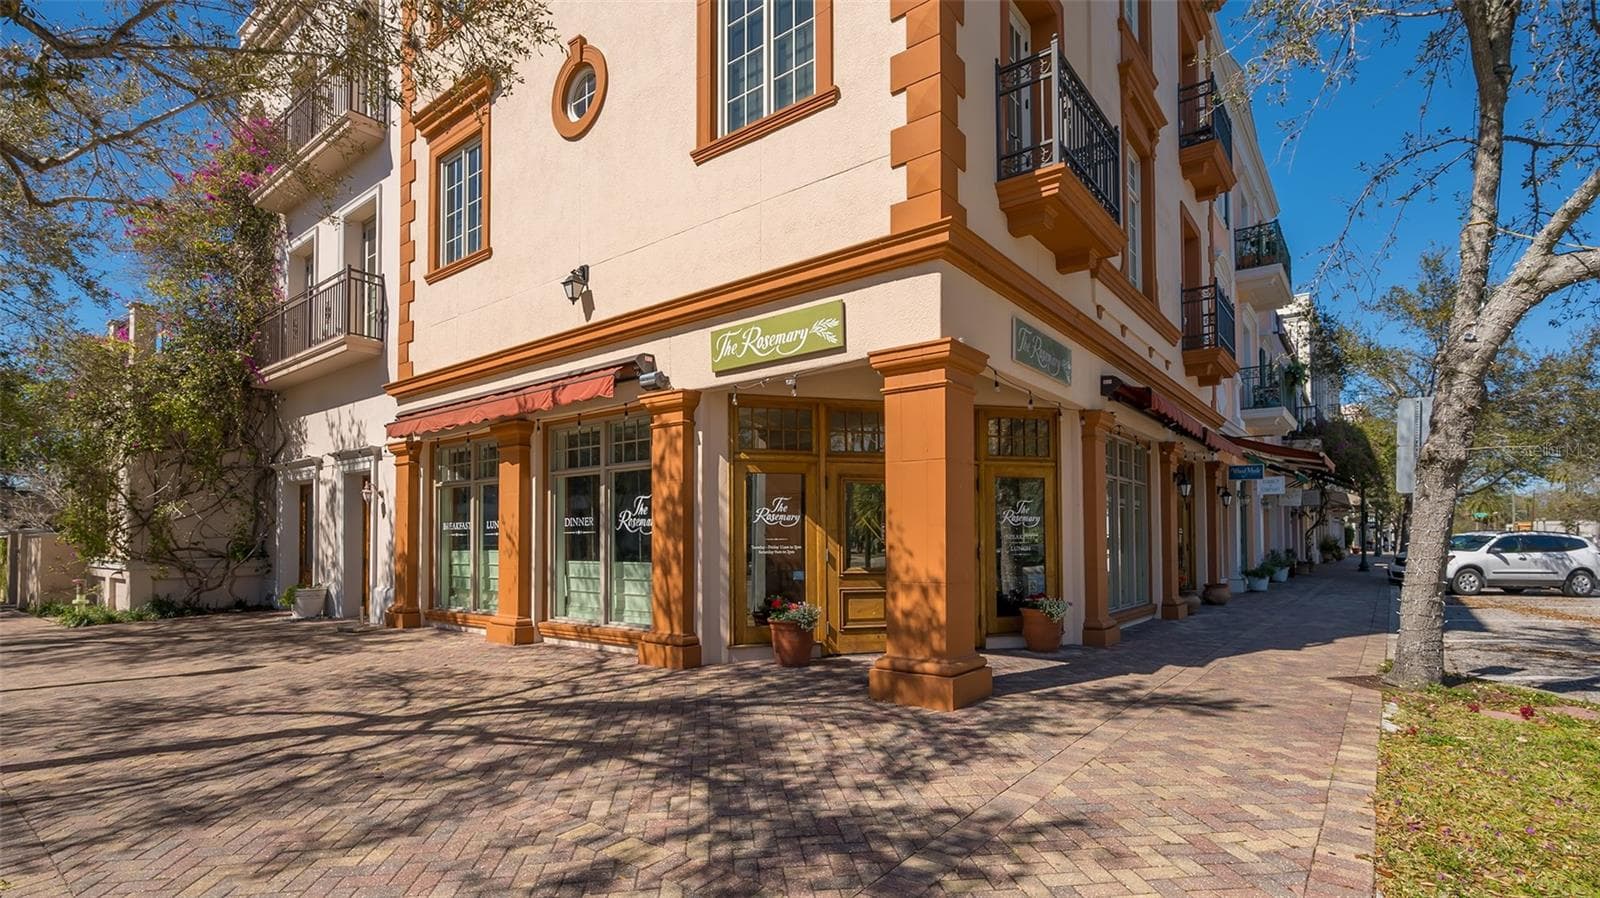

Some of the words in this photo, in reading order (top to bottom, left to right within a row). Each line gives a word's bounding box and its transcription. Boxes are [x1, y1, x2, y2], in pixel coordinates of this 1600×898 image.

[713, 328, 741, 362] The
[736, 326, 808, 357] Rosemary
[633, 494, 652, 516] The
[771, 497, 792, 513] The
[1016, 499, 1033, 514] The
[486, 521, 500, 530] LUN
[564, 517, 594, 527] DINNER
[753, 507, 801, 527] Rosemary
[1001, 509, 1041, 528] Rosemary
